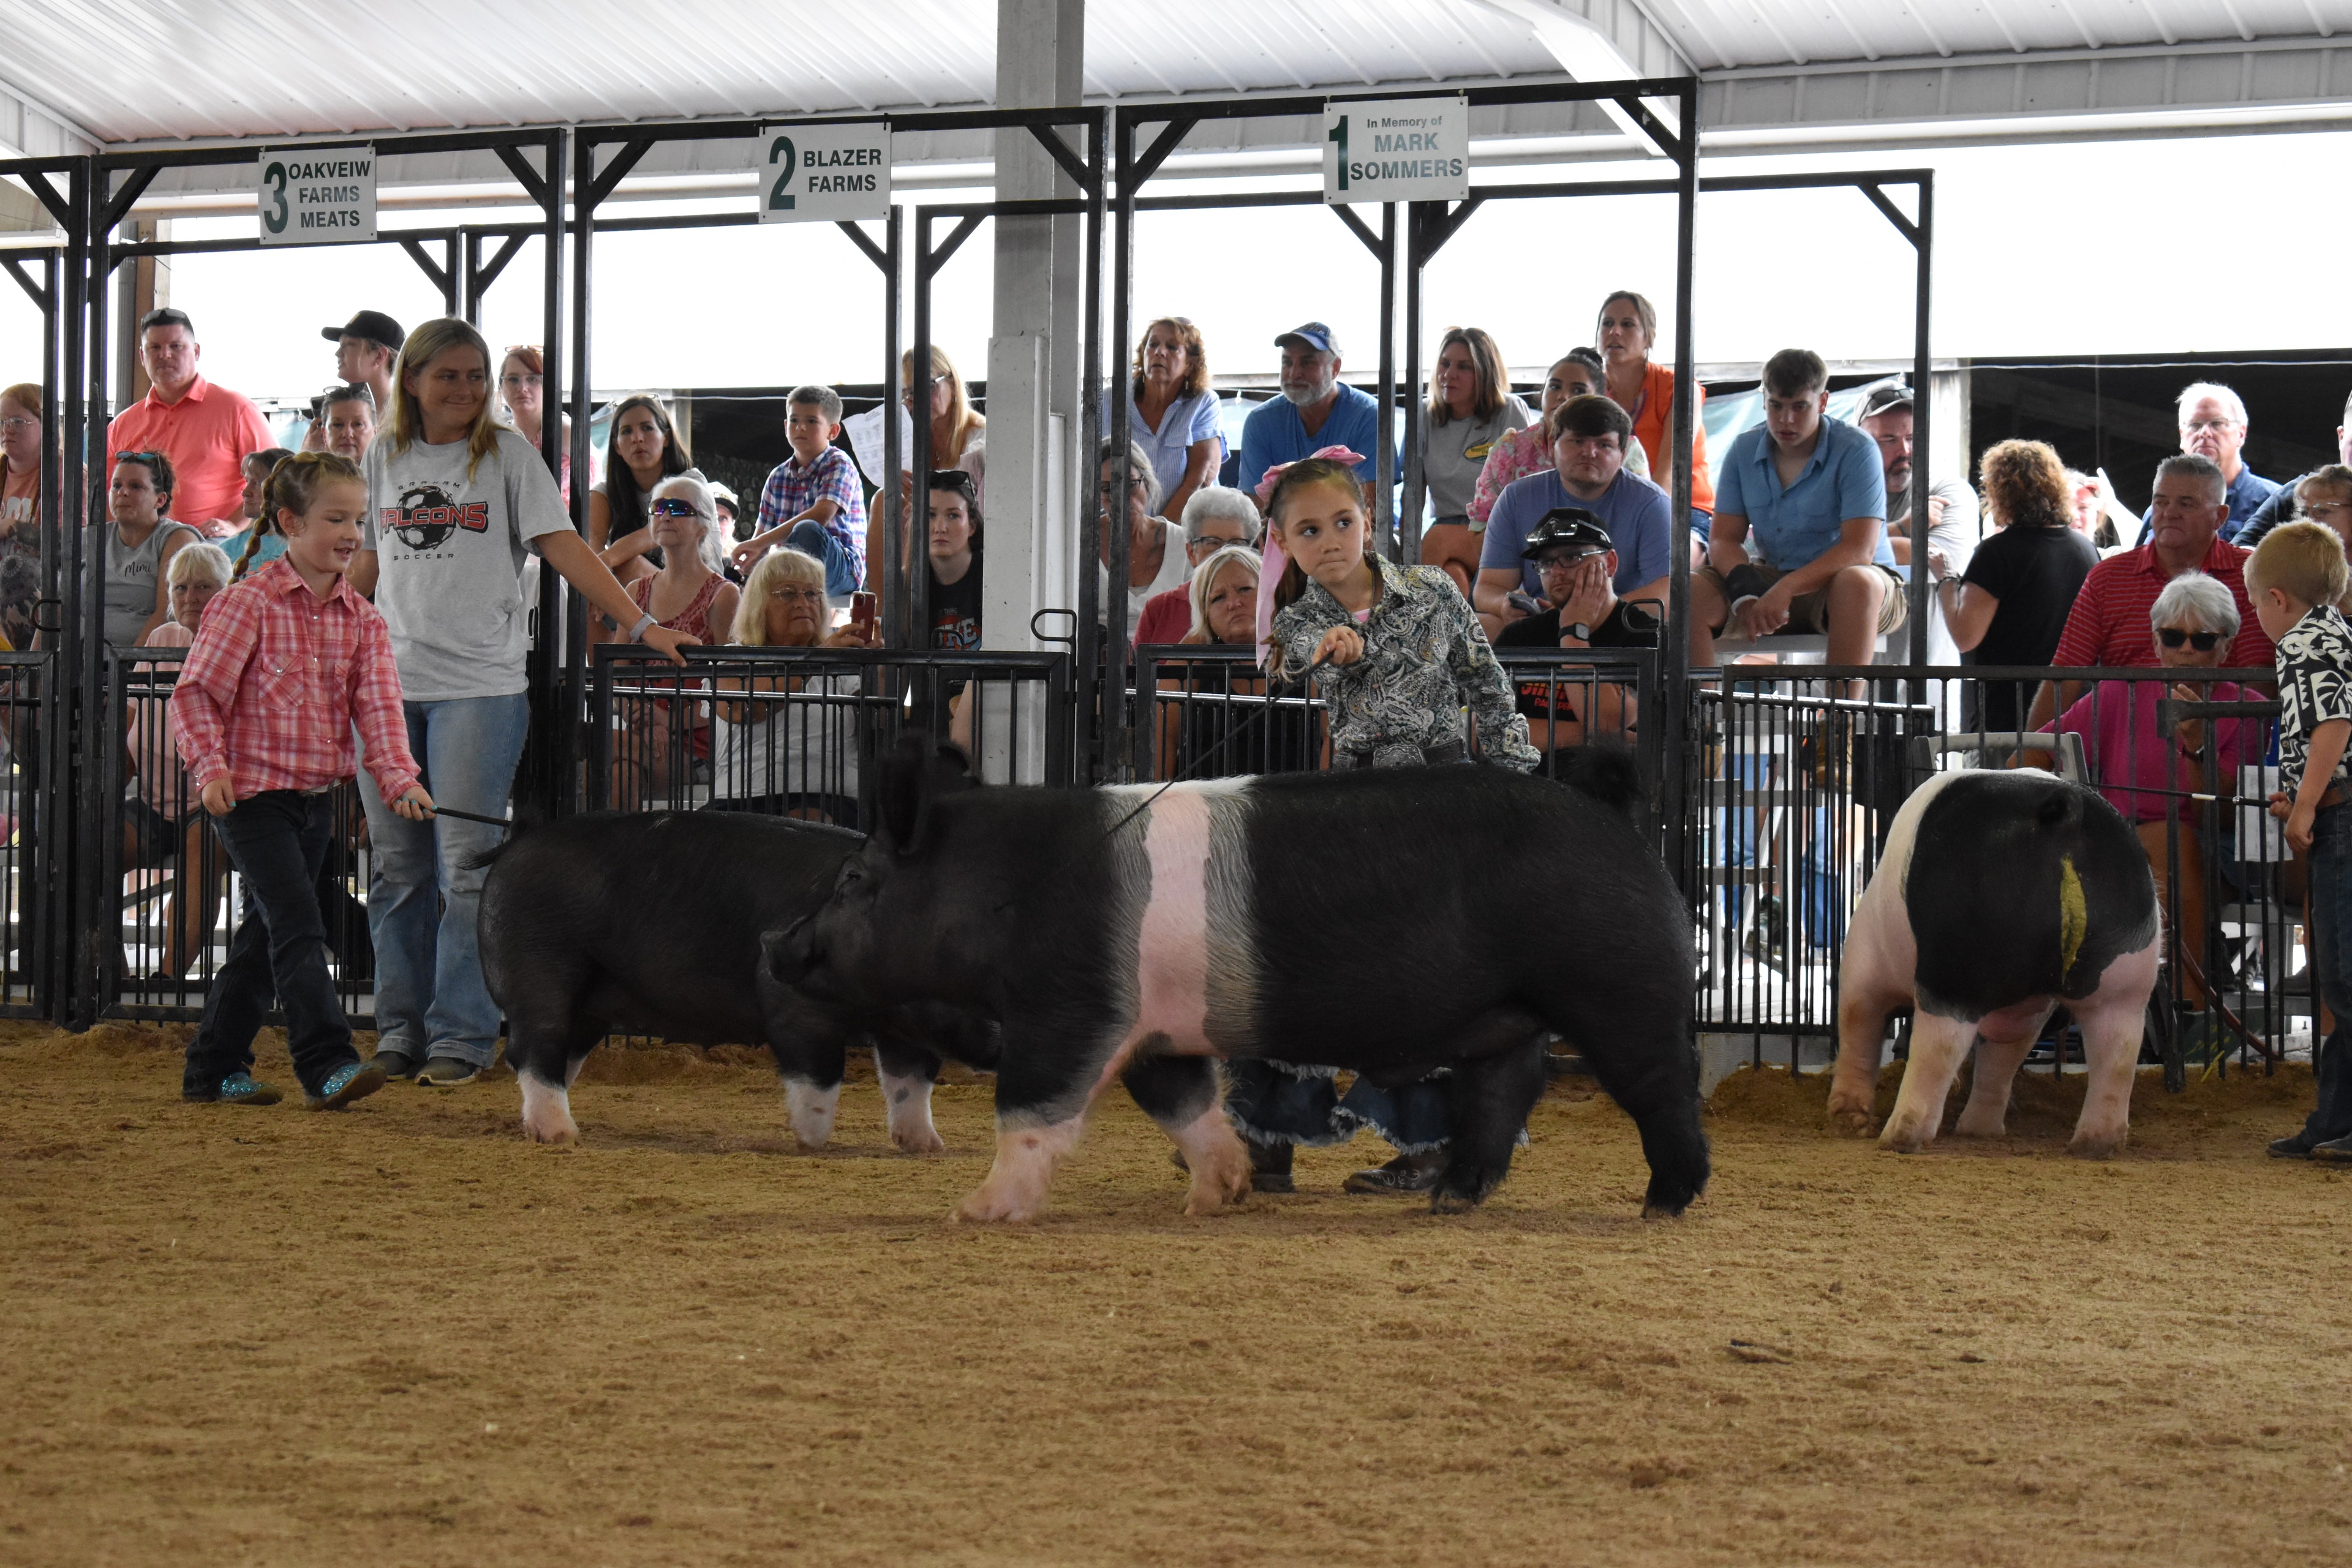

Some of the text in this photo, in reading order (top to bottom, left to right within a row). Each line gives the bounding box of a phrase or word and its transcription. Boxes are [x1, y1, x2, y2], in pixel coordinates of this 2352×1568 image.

[1367, 116, 1442, 128] In Memory of
[1374, 133, 1438, 152] MARK
[804, 149, 881, 167] BLAZER
[1329, 115, 1348, 190] 1
[288, 160, 371, 179] OAKVEIW
[769, 136, 796, 210] 2
[1351, 159, 1463, 181] SOMMERS
[809, 175, 876, 192] FARMS
[263, 162, 288, 234] 3
[299, 186, 360, 203] FARMS
[300, 210, 360, 228] MEATS
[380, 501, 489, 541] FALCONS
[124, 561, 152, 577] Mimi
